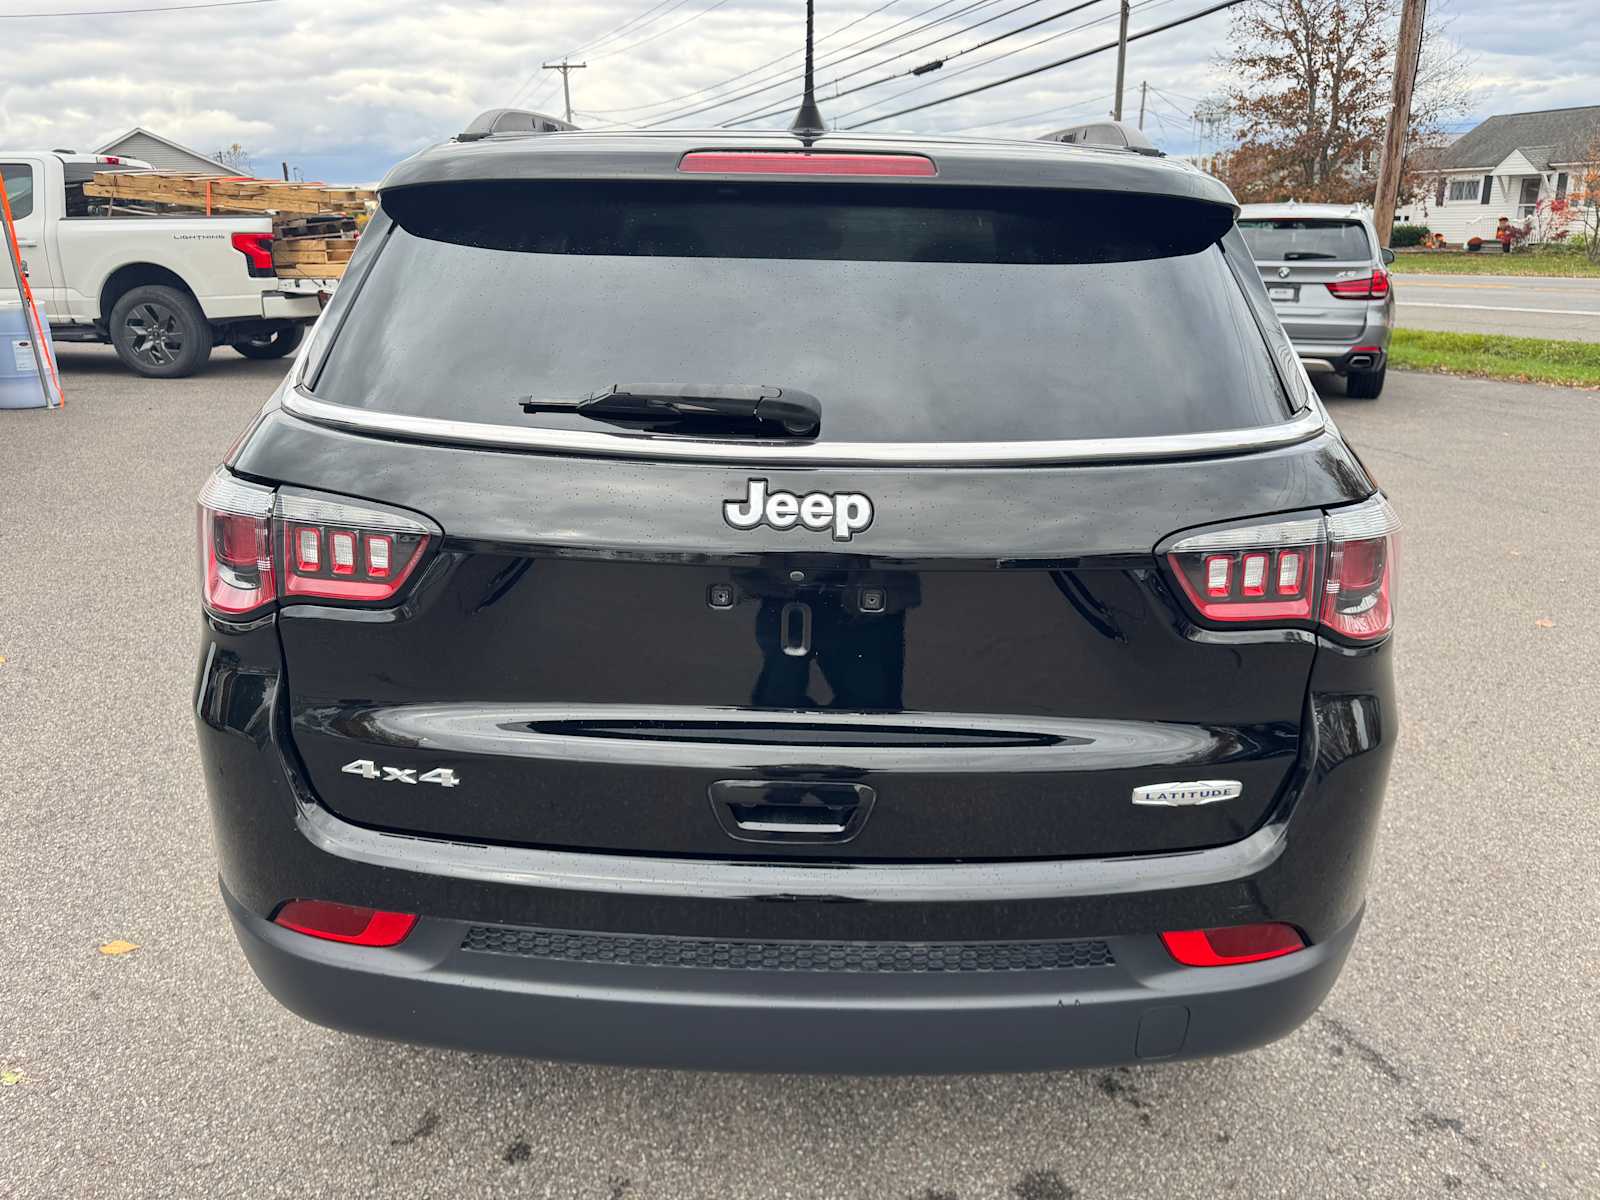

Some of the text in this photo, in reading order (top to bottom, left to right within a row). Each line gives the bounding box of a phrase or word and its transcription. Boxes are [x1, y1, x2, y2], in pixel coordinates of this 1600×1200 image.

[724, 478, 873, 540] Jeep
[341, 759, 460, 788] 4x4
[1145, 788, 1233, 800] LATITUDE
